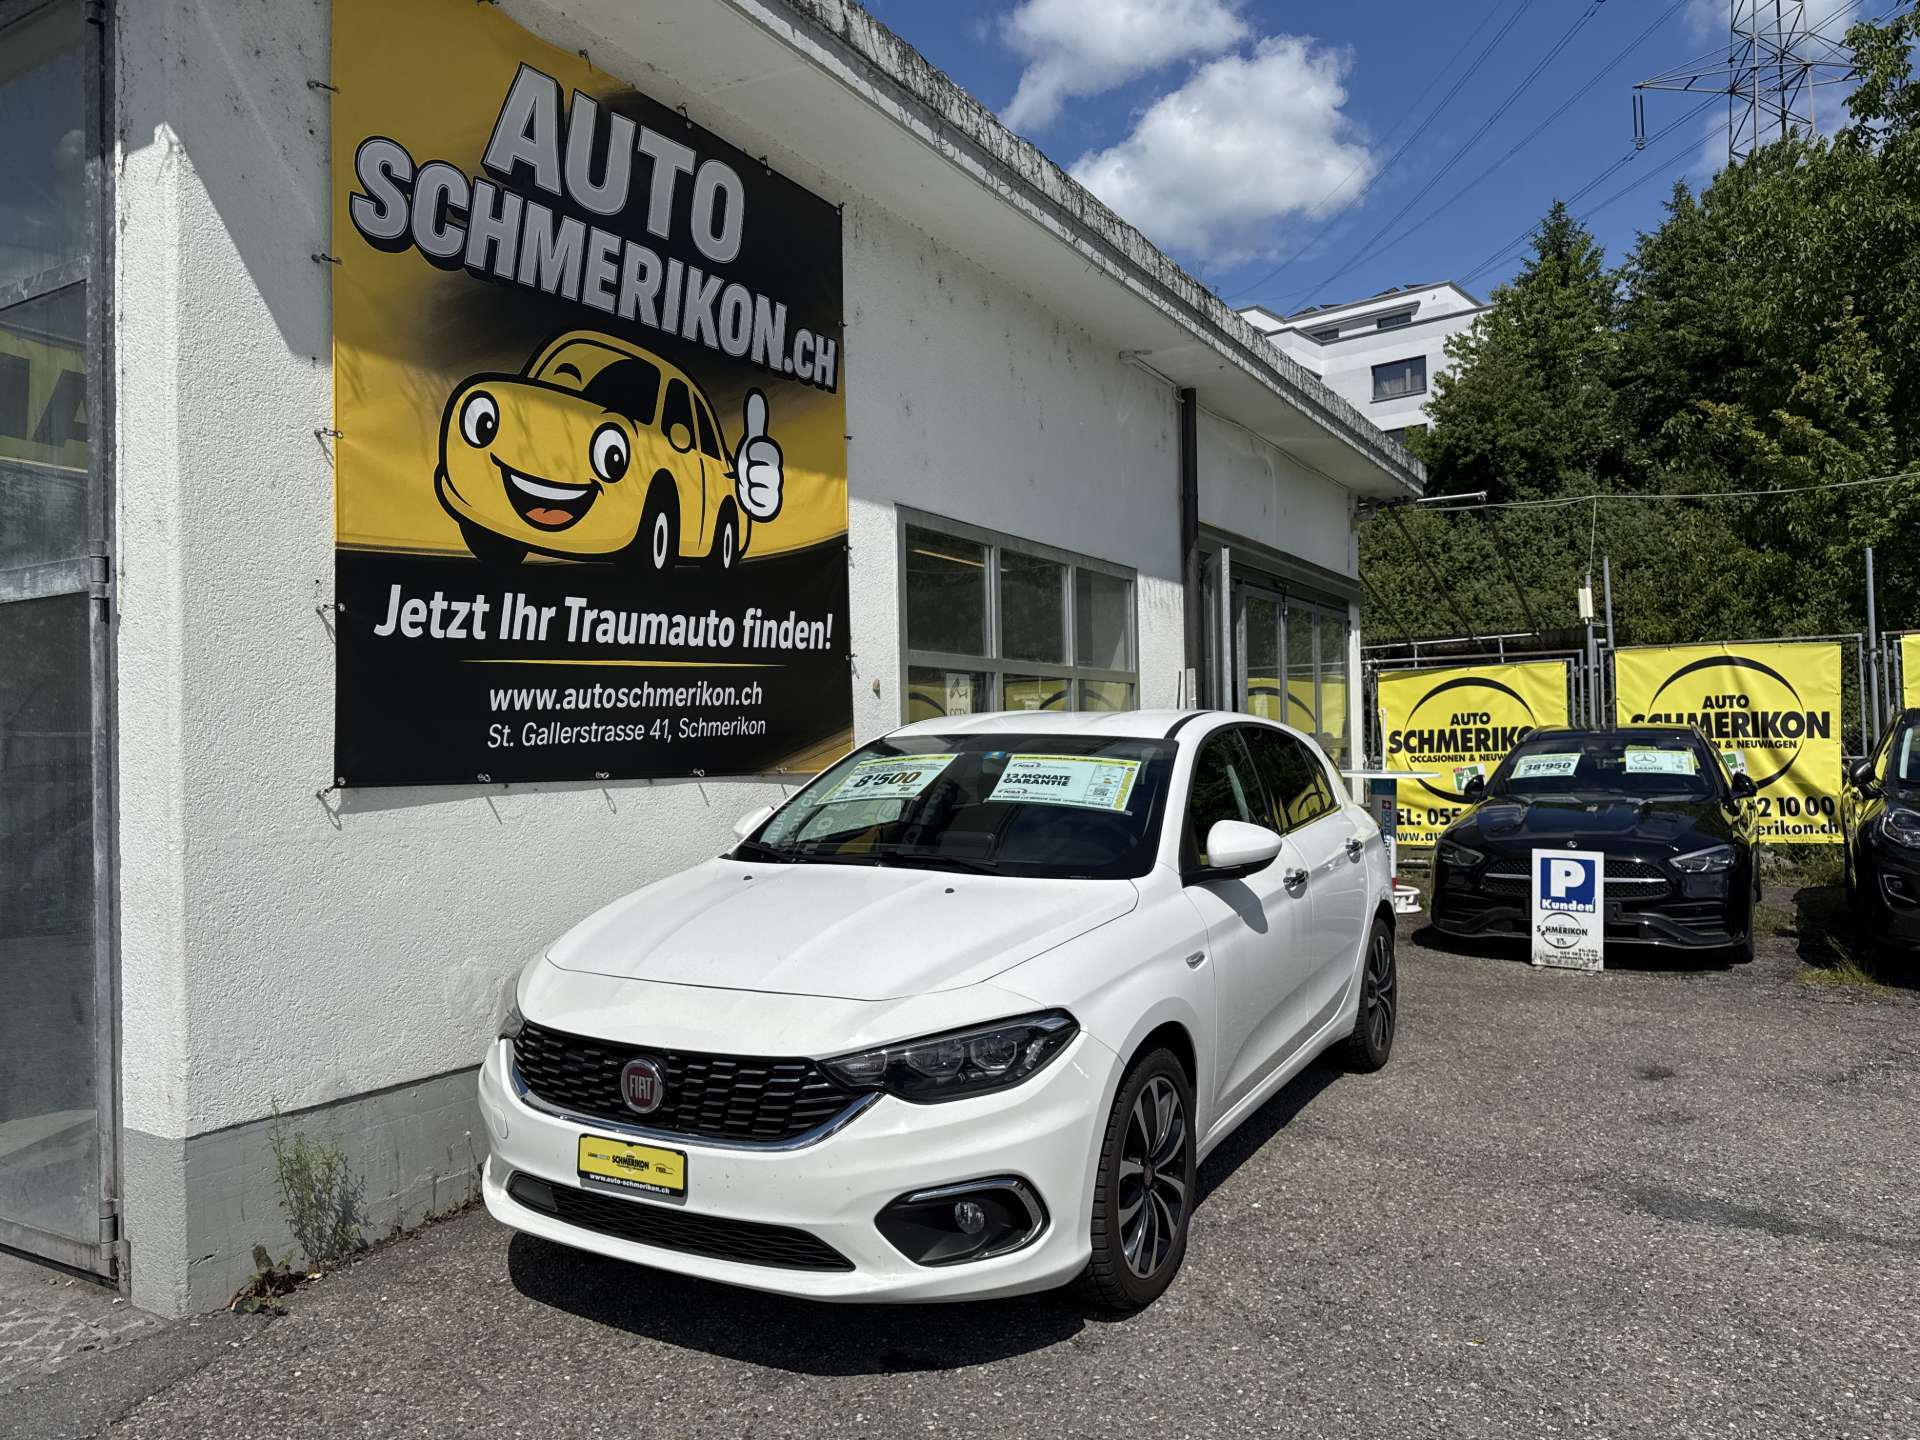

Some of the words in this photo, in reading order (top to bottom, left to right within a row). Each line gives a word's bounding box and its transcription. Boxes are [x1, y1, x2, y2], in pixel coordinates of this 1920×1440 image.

[482, 62, 745, 263] AUTO
[350, 137, 837, 388] SCHMERIKON.CH
[373, 585, 490, 640] Jetzt
[500, 593, 556, 642] Ihr
[564, 597, 734, 648] Traumauto
[743, 608, 832, 650] finden!
[489, 681, 763, 712] www.autoschmerikon.ch
[1702, 695, 1749, 709] AUTO
[1450, 712, 1491, 726] AUTO
[488, 724, 514, 749] St.
[522, 720, 644, 747] Gallerstrasse
[650, 719, 671, 743] 41,
[679, 717, 766, 739] Schmerikon
[1725, 741, 1733, 749] &
[1737, 740, 1797, 749] NEUWAGEN
[1410, 754, 1465, 763] OCCASIONEN
[1469, 754, 1476, 762] &
[1479, 753, 1507, 762] NEUW
[854, 771, 922, 788] 8'500
[1003, 778, 1070, 787] GARANTIE
[1020, 773, 1071, 781] MONATE
[1757, 797, 1771, 817] 2
[1805, 796, 1835, 817] 00
[1397, 809, 1421, 826] EL:
[1758, 819, 1839, 836] erikon.ch
[1550, 859, 1586, 898] P
[1541, 899, 1594, 912] Kunden
[629, 1074, 652, 1100] FIAT
